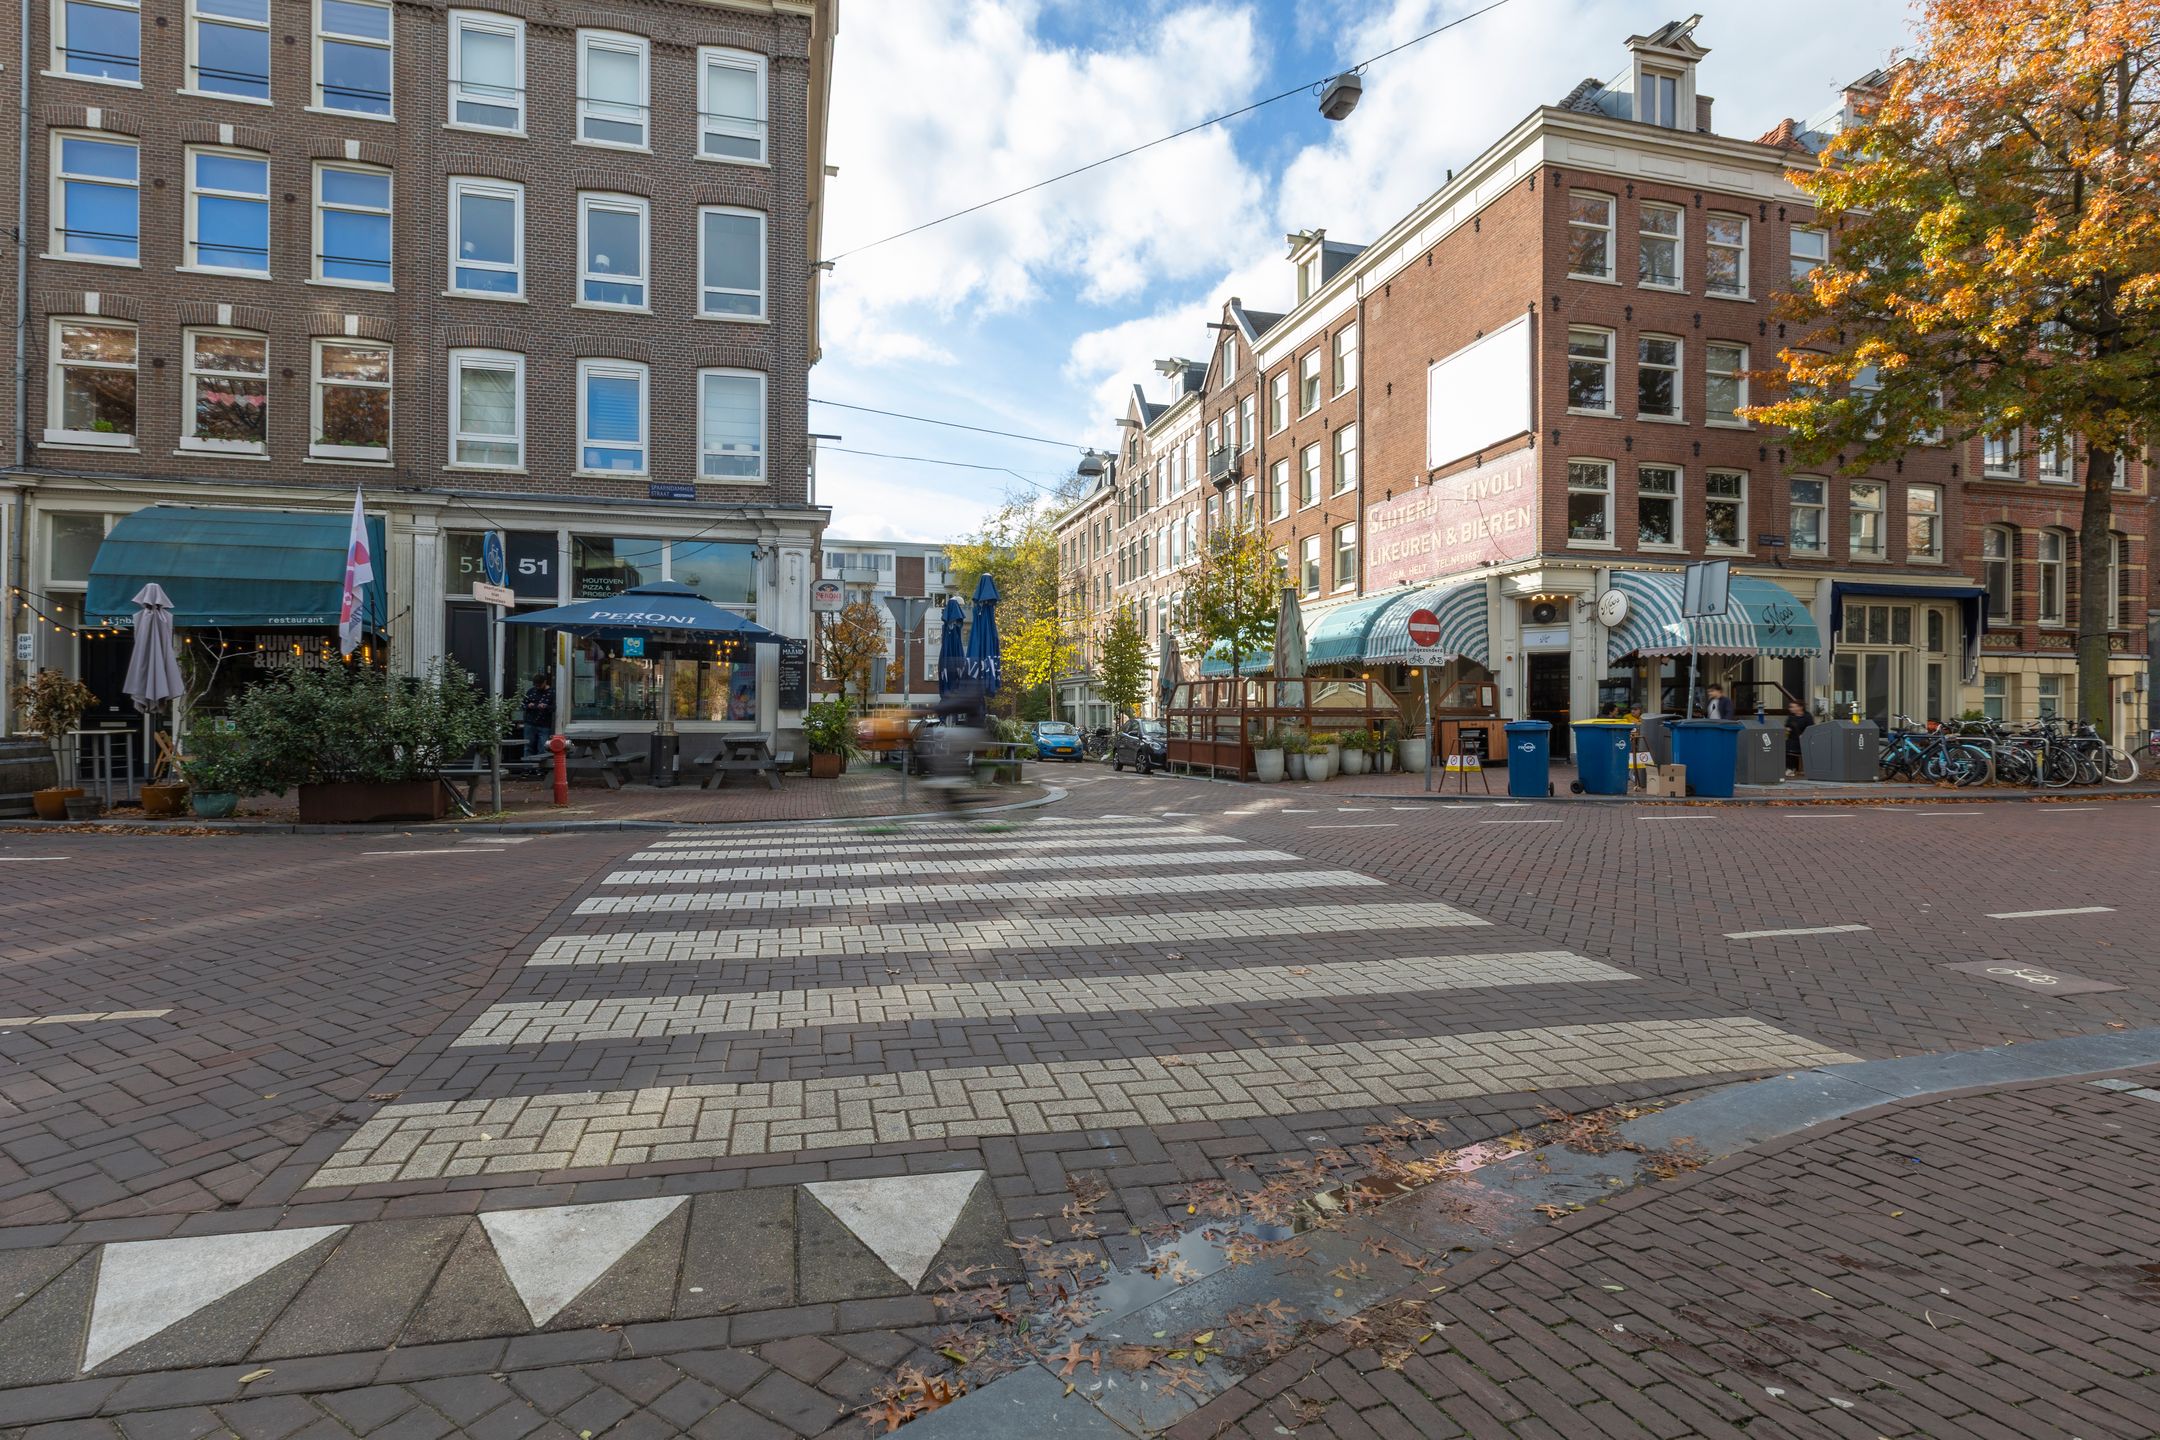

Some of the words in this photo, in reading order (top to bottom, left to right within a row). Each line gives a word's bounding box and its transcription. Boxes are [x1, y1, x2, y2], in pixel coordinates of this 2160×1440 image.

[1369, 529, 1442, 567] LIKEUREN
[1445, 527, 1458, 547] &
[1461, 504, 1531, 543] BIEREN
[460, 556, 487, 574] 51
[518, 558, 548, 575] 51
[1408, 563, 1428, 576] HELT
[582, 577, 624, 585] HOUTOVEN
[816, 591, 842, 600] PERONI
[268, 616, 324, 624] restaurant
[588, 611, 697, 625] PERONI
